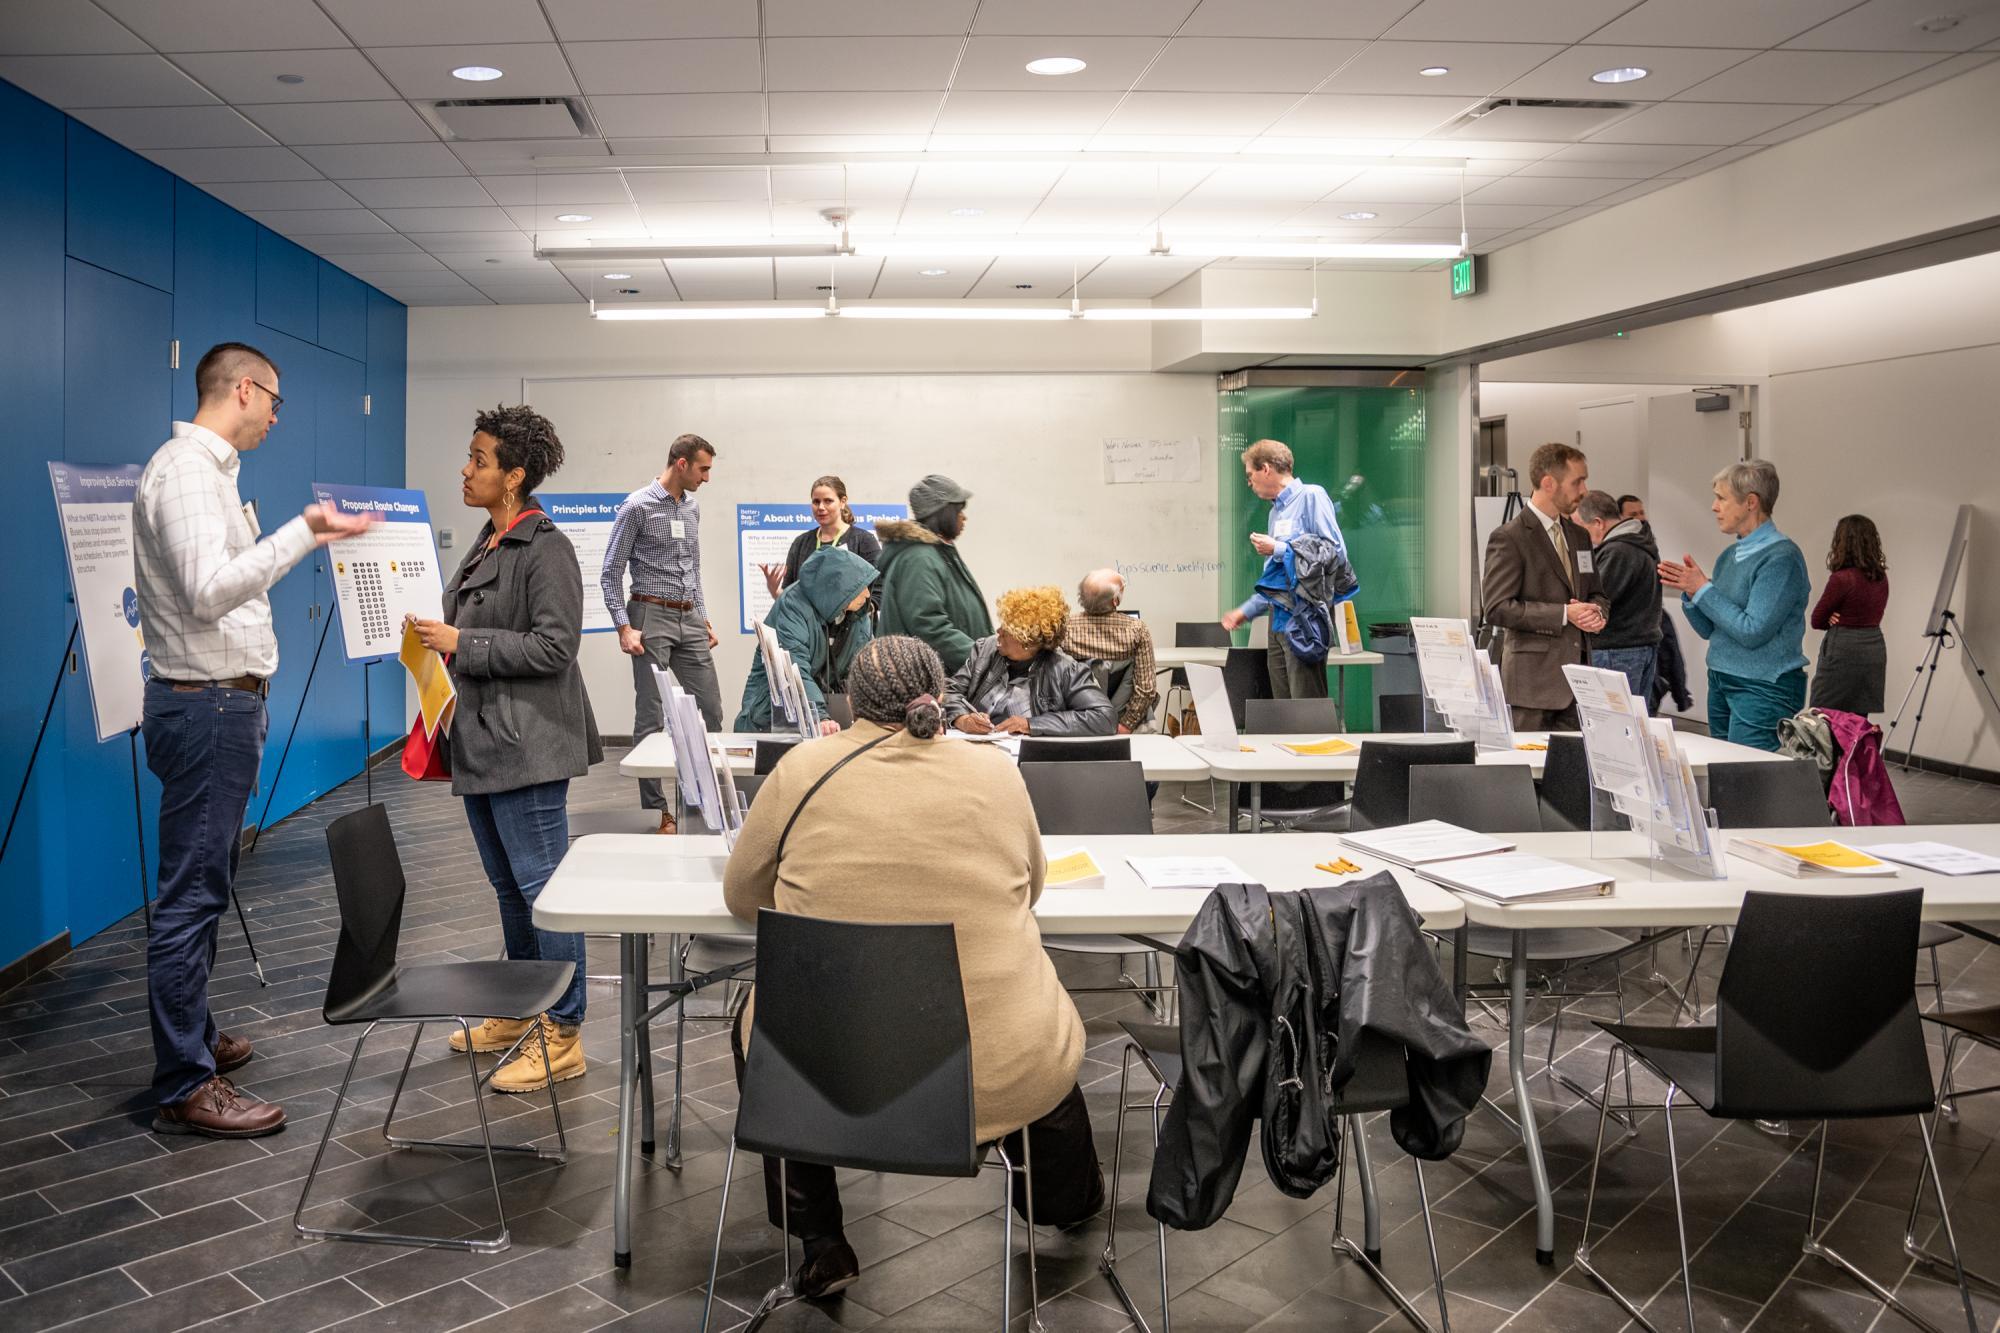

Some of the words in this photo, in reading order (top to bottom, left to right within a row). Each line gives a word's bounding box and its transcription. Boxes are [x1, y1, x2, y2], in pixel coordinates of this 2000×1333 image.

[80, 476, 107, 489] Improving
[107, 476, 116, 487] Bus
[116, 476, 134, 487] Service
[342, 499, 374, 512] Proposed
[374, 501, 393, 512] Route
[394, 502, 420, 514] Changes
[552, 504, 597, 515] Principles
[599, 504, 612, 513] for
[763, 514, 794, 523] About
[795, 514, 813, 523] the
